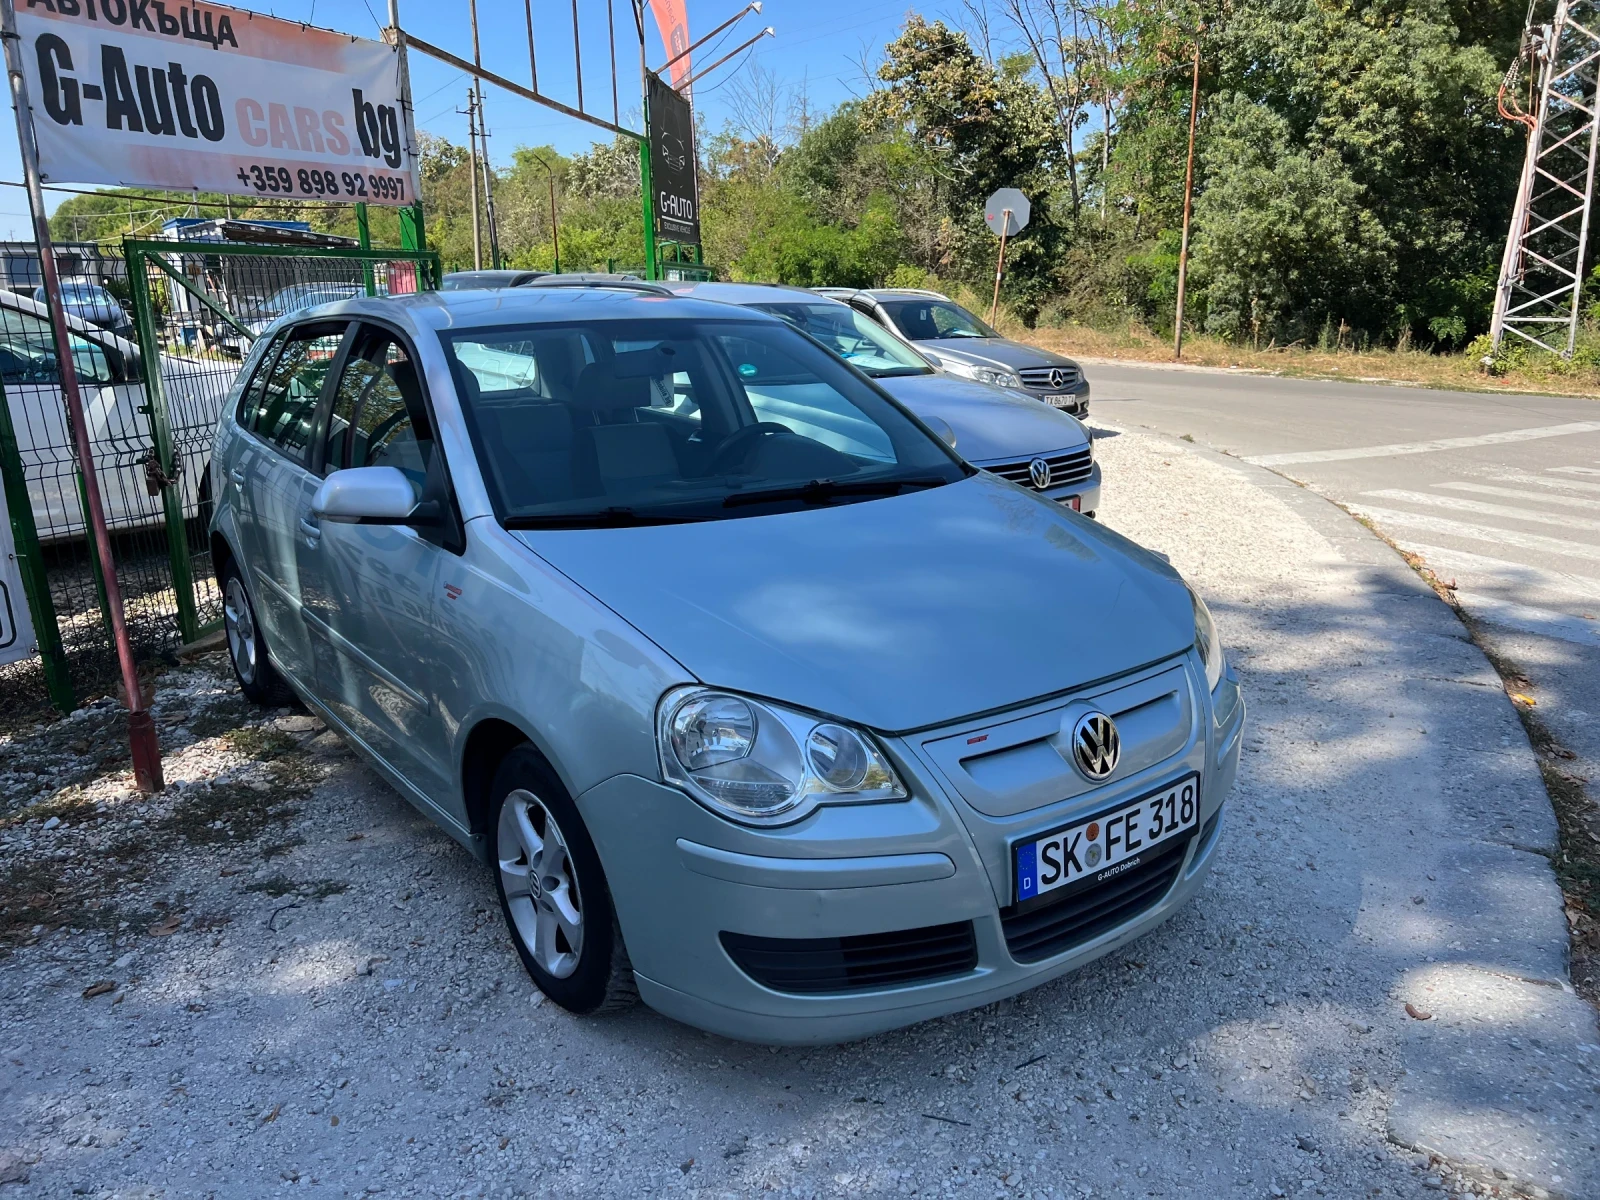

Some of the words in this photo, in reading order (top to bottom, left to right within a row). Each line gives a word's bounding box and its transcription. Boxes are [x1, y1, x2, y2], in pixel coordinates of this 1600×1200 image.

[35, 32, 225, 142] G-Auto
[237, 165, 293, 193] +359
[297, 168, 339, 195] 898
[342, 172, 368, 197] 92
[368, 174, 405, 200] 9997
[660, 191, 693, 220] G-AUTO
[1041, 831, 1083, 885] SK
[1105, 808, 1142, 861] FE
[1149, 785, 1194, 840] 318
[1023, 877, 1031, 890] D
[1097, 866, 1120, 881] G-AUTO
[1120, 857, 1141, 872] Dobrich
